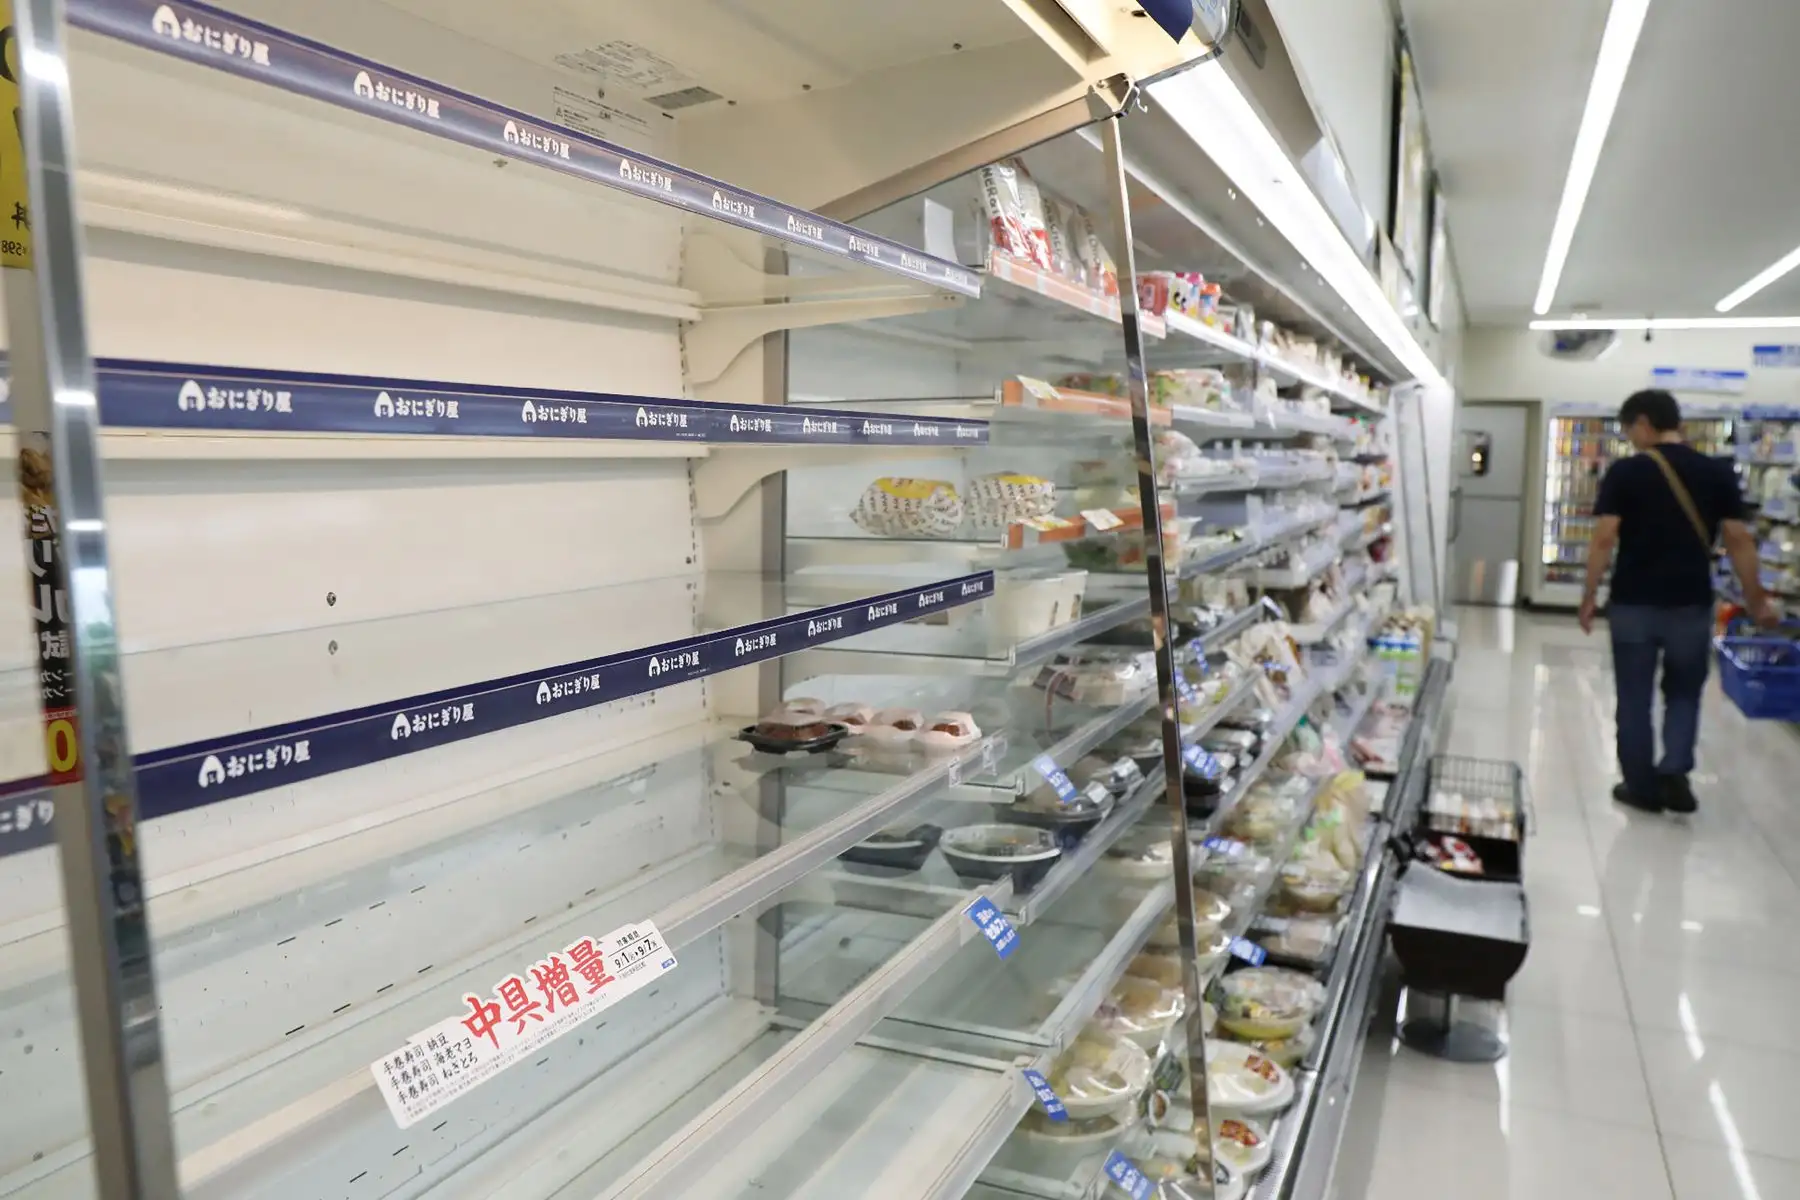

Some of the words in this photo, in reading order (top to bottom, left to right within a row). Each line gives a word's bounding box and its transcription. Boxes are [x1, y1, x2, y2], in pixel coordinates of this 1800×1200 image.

[182, 19, 270, 66] おにぎり屋
[375, 81, 440, 120] おにぎり屋
[520, 129, 570, 160] おにぎり屋
[633, 167, 672, 193] おにぎり屋
[722, 196, 755, 219] おにぎり屋
[795, 221, 823, 241] おにぎり屋
[207, 386, 293, 414] おにぎり屋
[395, 397, 460, 419] おにぎり屋
[537, 405, 588, 424] おにぎり屋
[648, 411, 688, 428] おにぎり屋
[739, 417, 772, 433] おにぎり屋
[809, 420, 838, 434] おにぎり屋
[815, 616, 843, 635] おにぎり屋
[744, 633, 777, 653] おにぎり屋
[661, 651, 700, 673] おにぎり屋
[552, 674, 601, 699] おにぎり屋
[412, 702, 475, 733] おにぎり屋
[227, 739, 311, 777] おにぎり屋
[461, 939, 616, 1049] 中具増量
[383, 1045, 425, 1075] 手巻寿司
[426, 1032, 449, 1051] 納豆
[391, 1059, 432, 1090] 手巻寿司
[434, 1037, 472, 1065] 海老マヨ
[398, 1073, 439, 1105] 手巻寿司
[442, 1052, 478, 1079] ねぎとろ
